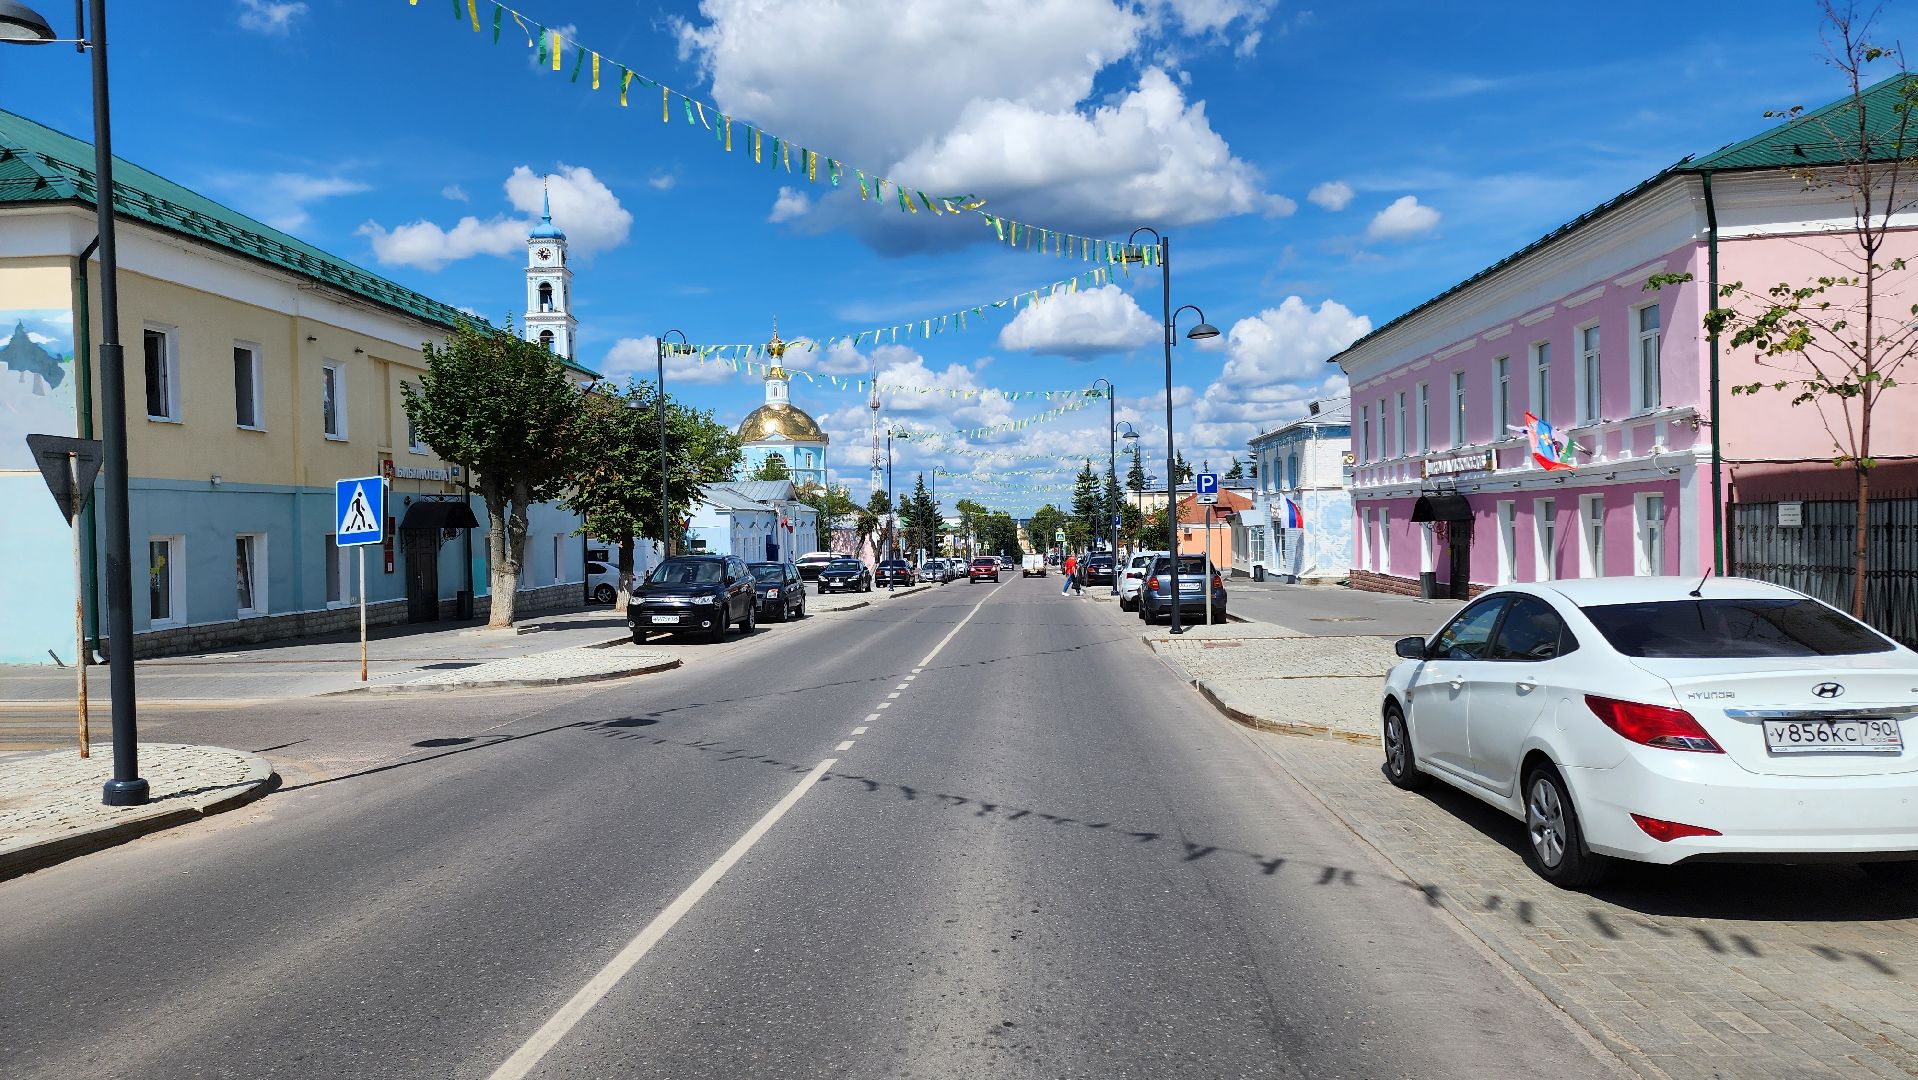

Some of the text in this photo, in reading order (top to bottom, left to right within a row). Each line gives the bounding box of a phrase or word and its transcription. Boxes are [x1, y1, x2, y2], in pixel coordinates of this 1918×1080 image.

[1201, 475, 1214, 493] P
[1687, 691, 1736, 700] HYUNDAI
[1859, 720, 1892, 737] 790
